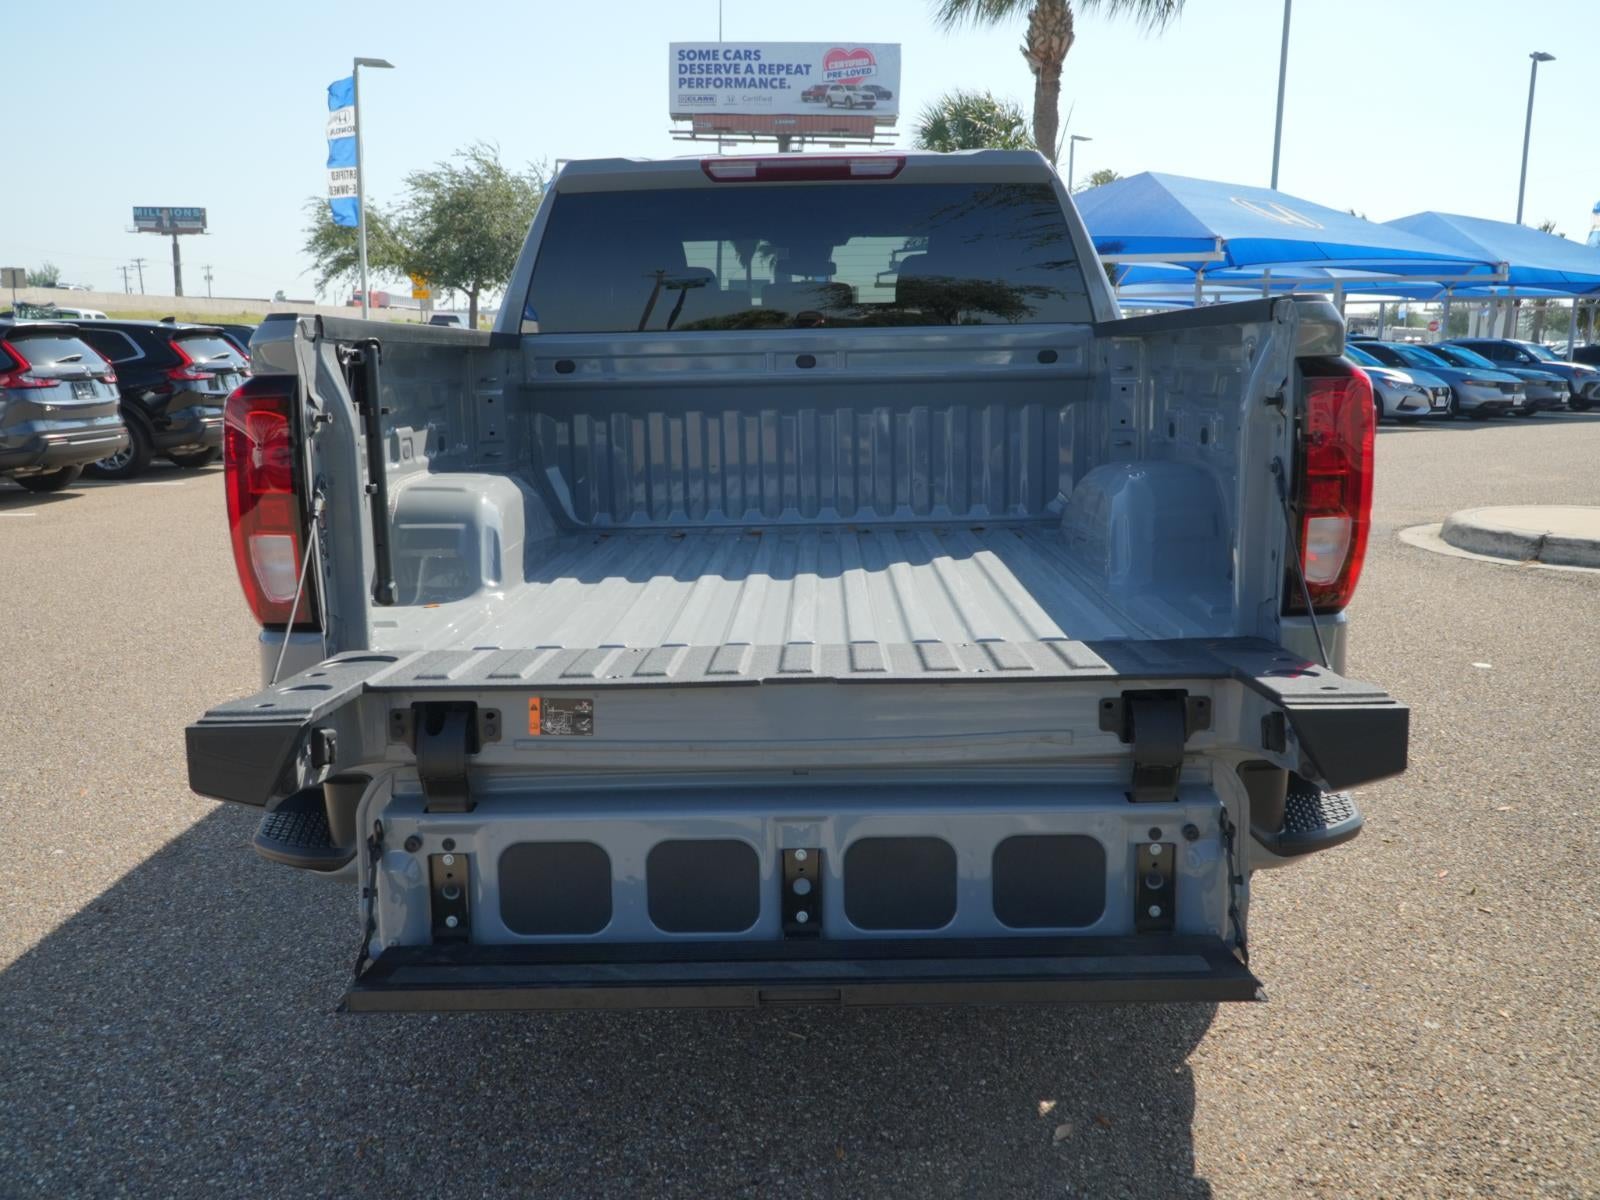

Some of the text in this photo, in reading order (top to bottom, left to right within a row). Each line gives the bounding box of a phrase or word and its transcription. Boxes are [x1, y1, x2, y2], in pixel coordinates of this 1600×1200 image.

[678, 49, 761, 61] SOME CARS
[678, 64, 812, 76] DESERVE A REPEAT
[827, 67, 872, 79] PRE-LOVED
[678, 78, 791, 90] PERFORMANCE.
